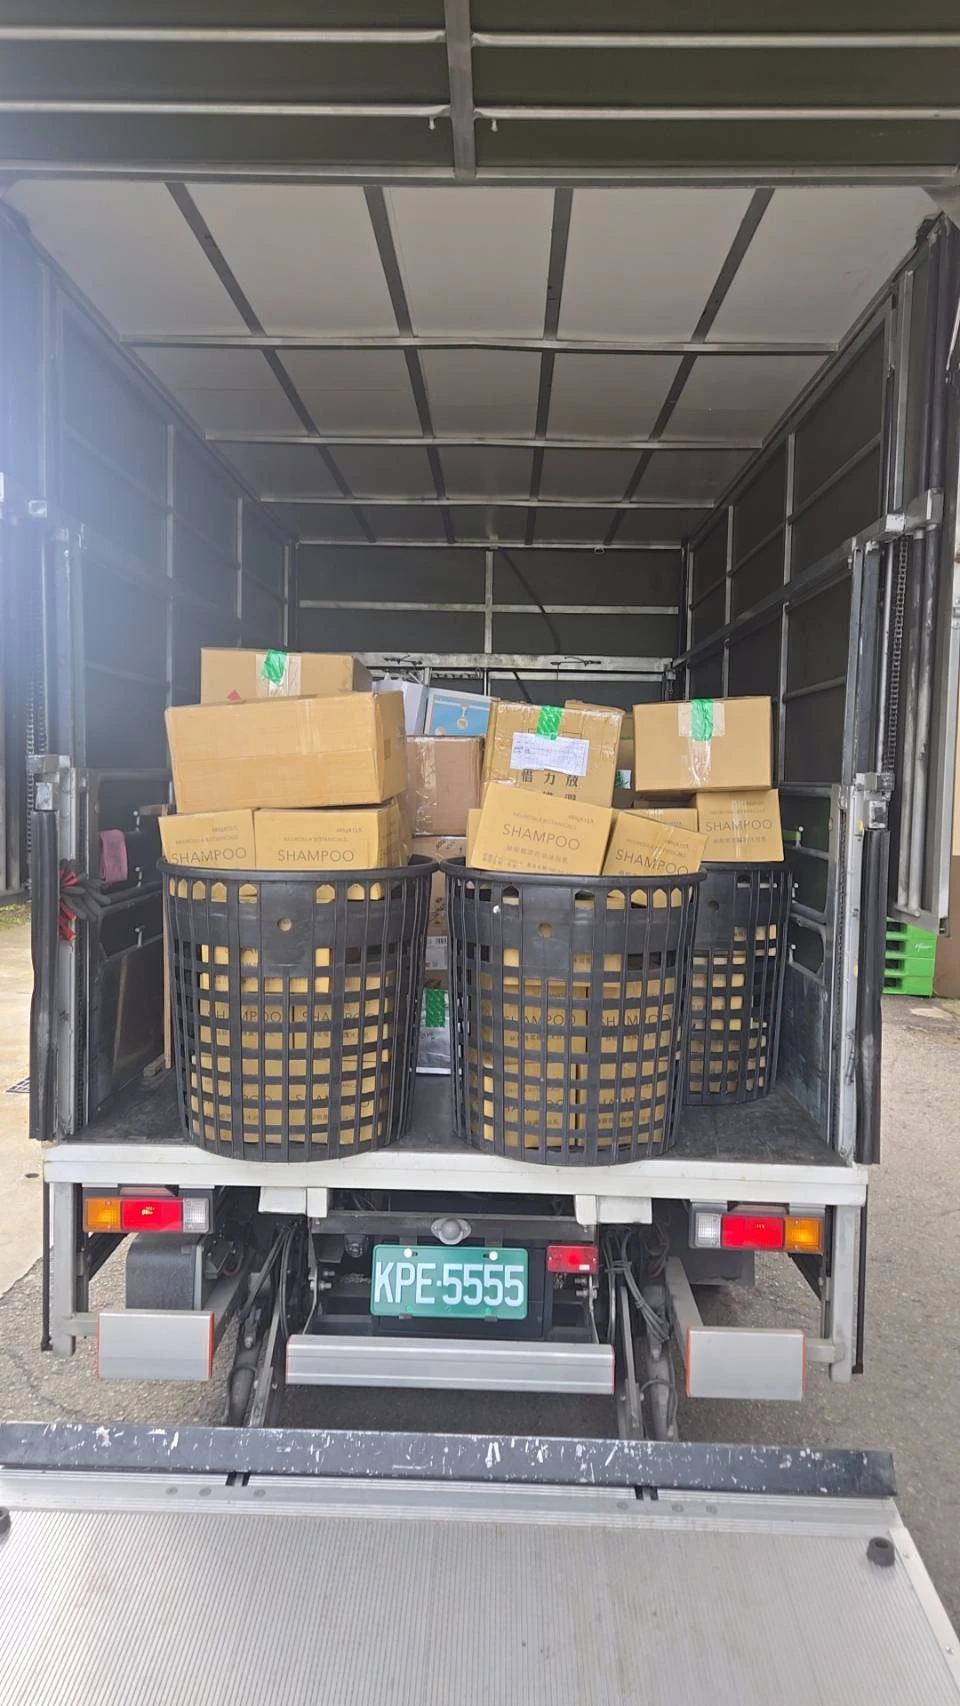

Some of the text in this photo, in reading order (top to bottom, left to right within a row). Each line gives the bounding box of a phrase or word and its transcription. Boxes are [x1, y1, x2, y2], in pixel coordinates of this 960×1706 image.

[503, 823, 581, 851] SHAMPOO
[705, 819, 773, 833] SHAMPOO
[171, 847, 247, 865] SHAMPOO
[278, 849, 354, 862] SHAMPOO
[615, 849, 689, 876] SHAMPOO
[374, 1261, 525, 1307] KPE-5555
